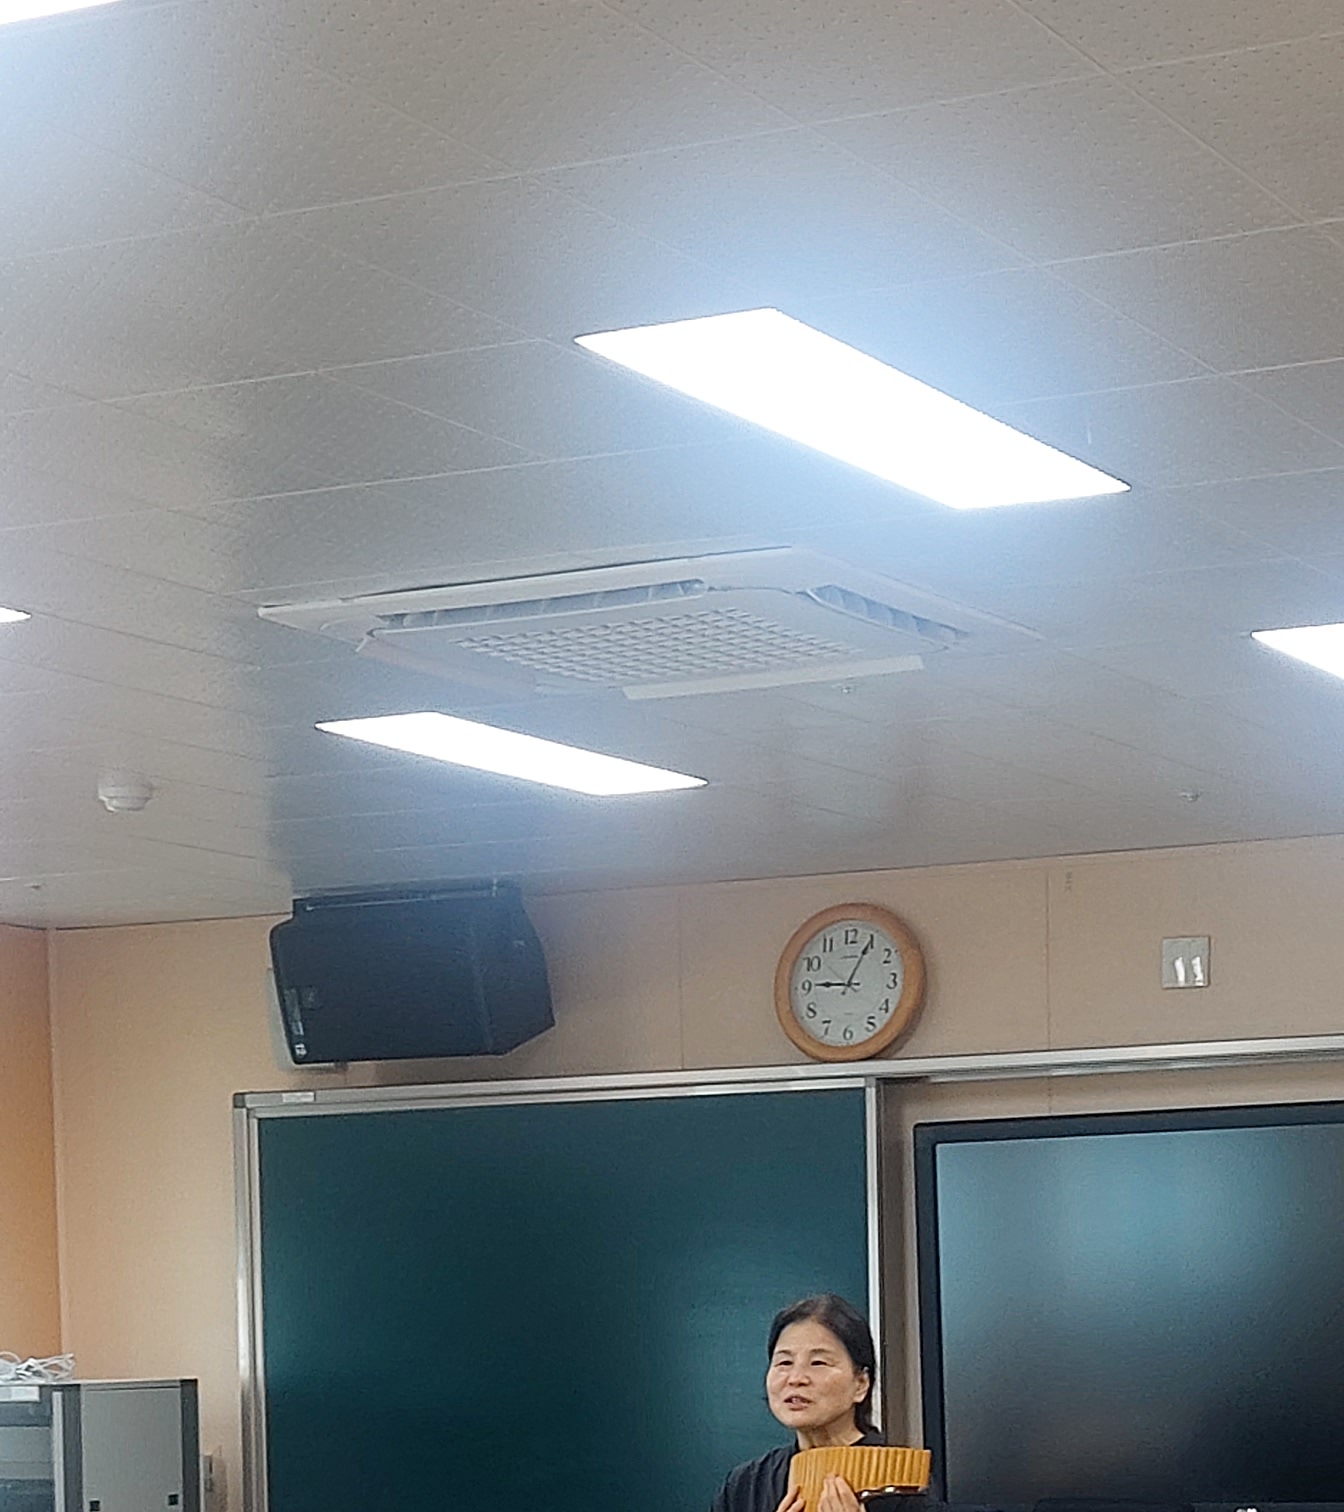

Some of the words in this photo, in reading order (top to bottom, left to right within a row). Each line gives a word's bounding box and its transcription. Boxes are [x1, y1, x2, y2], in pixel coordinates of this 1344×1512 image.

[822, 936, 834, 953] 11
[844, 928, 859, 945] 12
[803, 955, 821, 972] 10
[882, 948, 893, 964] 2
[801, 979, 813, 996] 9
[886, 972, 898, 990] 3
[806, 1002, 817, 1019] 8
[879, 998, 890, 1014] 4
[822, 1019, 832, 1037] 7
[864, 1016, 877, 1032] 5
[843, 1026, 854, 1041] 6
